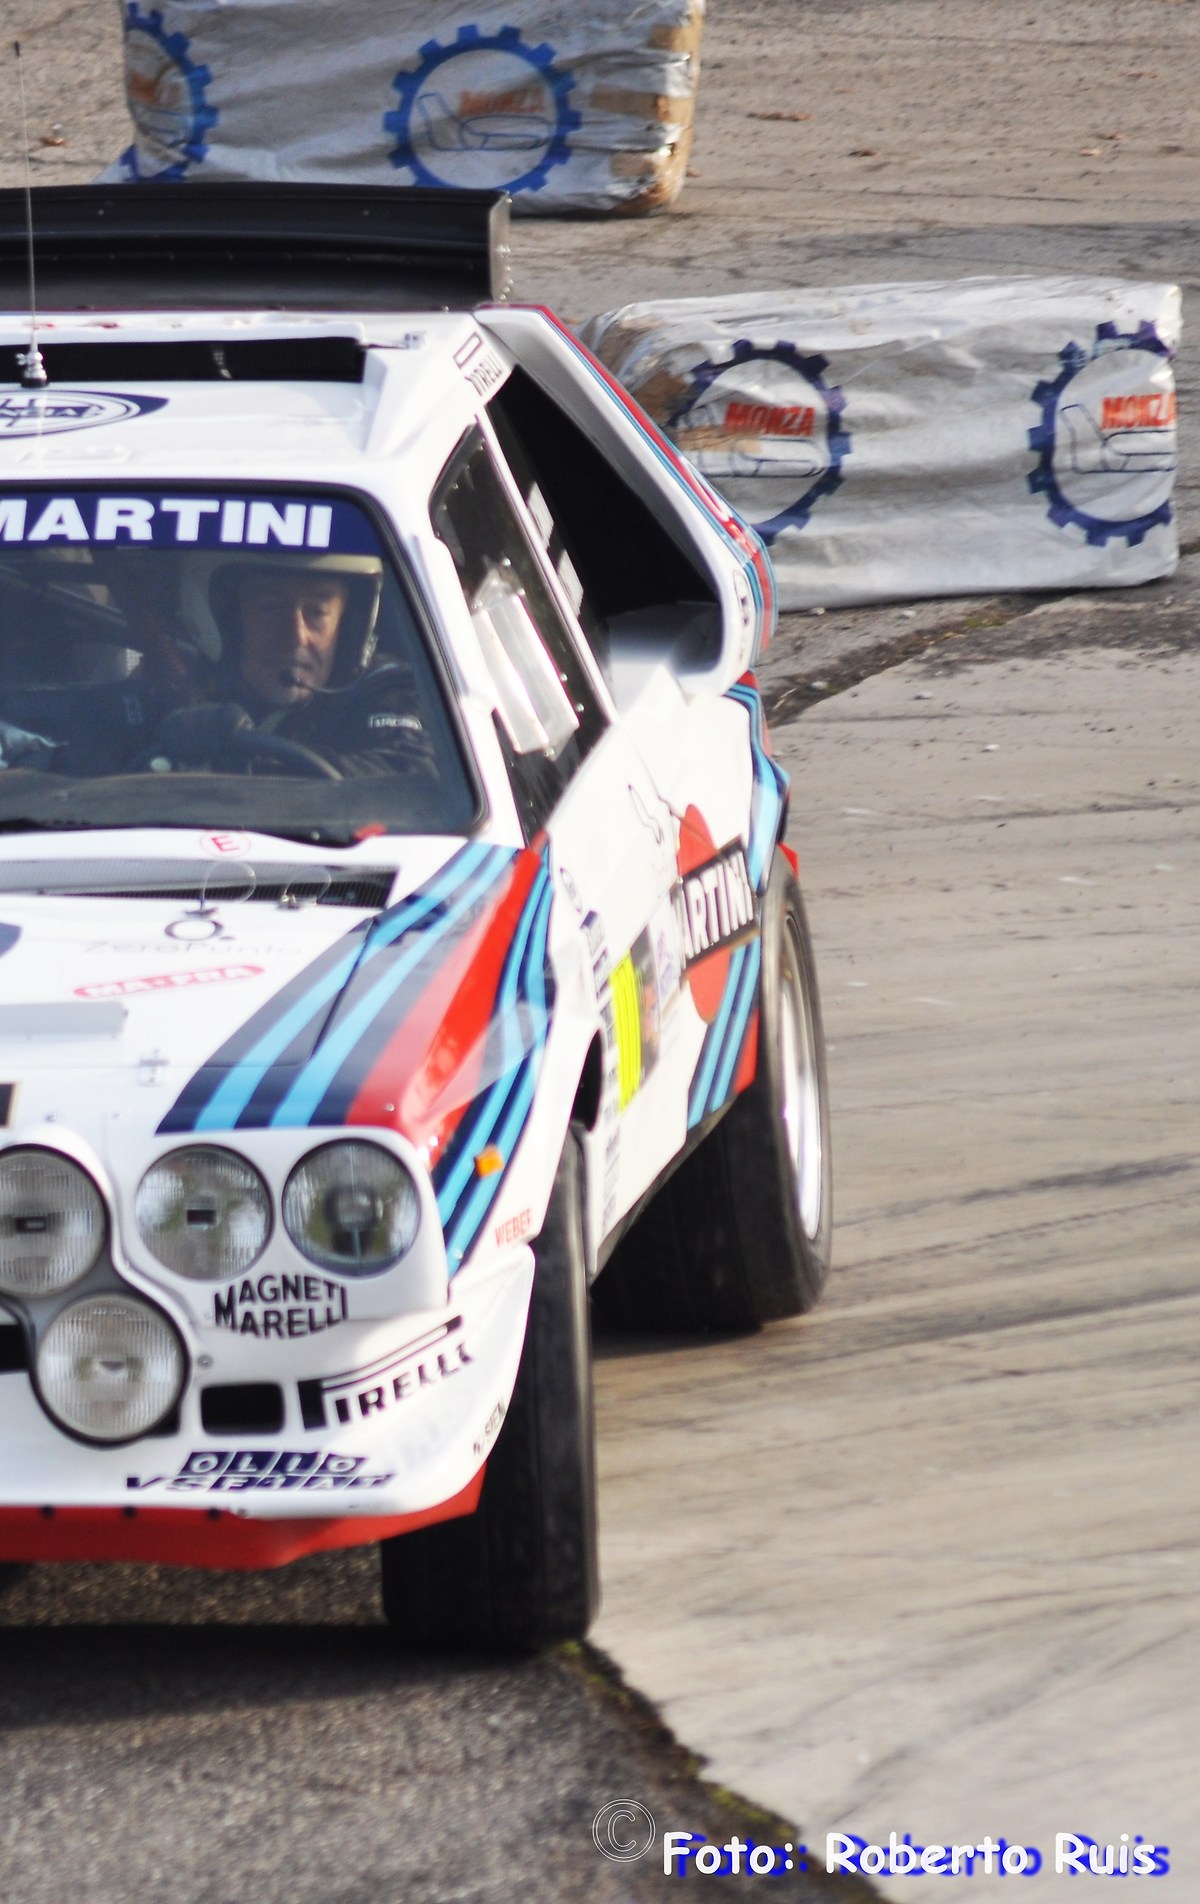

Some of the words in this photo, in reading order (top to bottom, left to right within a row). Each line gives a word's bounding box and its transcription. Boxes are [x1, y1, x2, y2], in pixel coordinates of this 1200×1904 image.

[725, 403, 815, 436] MONZA
[211, 835, 240, 853] E
[214, 1274, 348, 1312] MAGNETI
[214, 1293, 348, 1339] MARELLI
[297, 1315, 474, 1432] PIRELLI
[188, 1451, 366, 1475] OLIO
